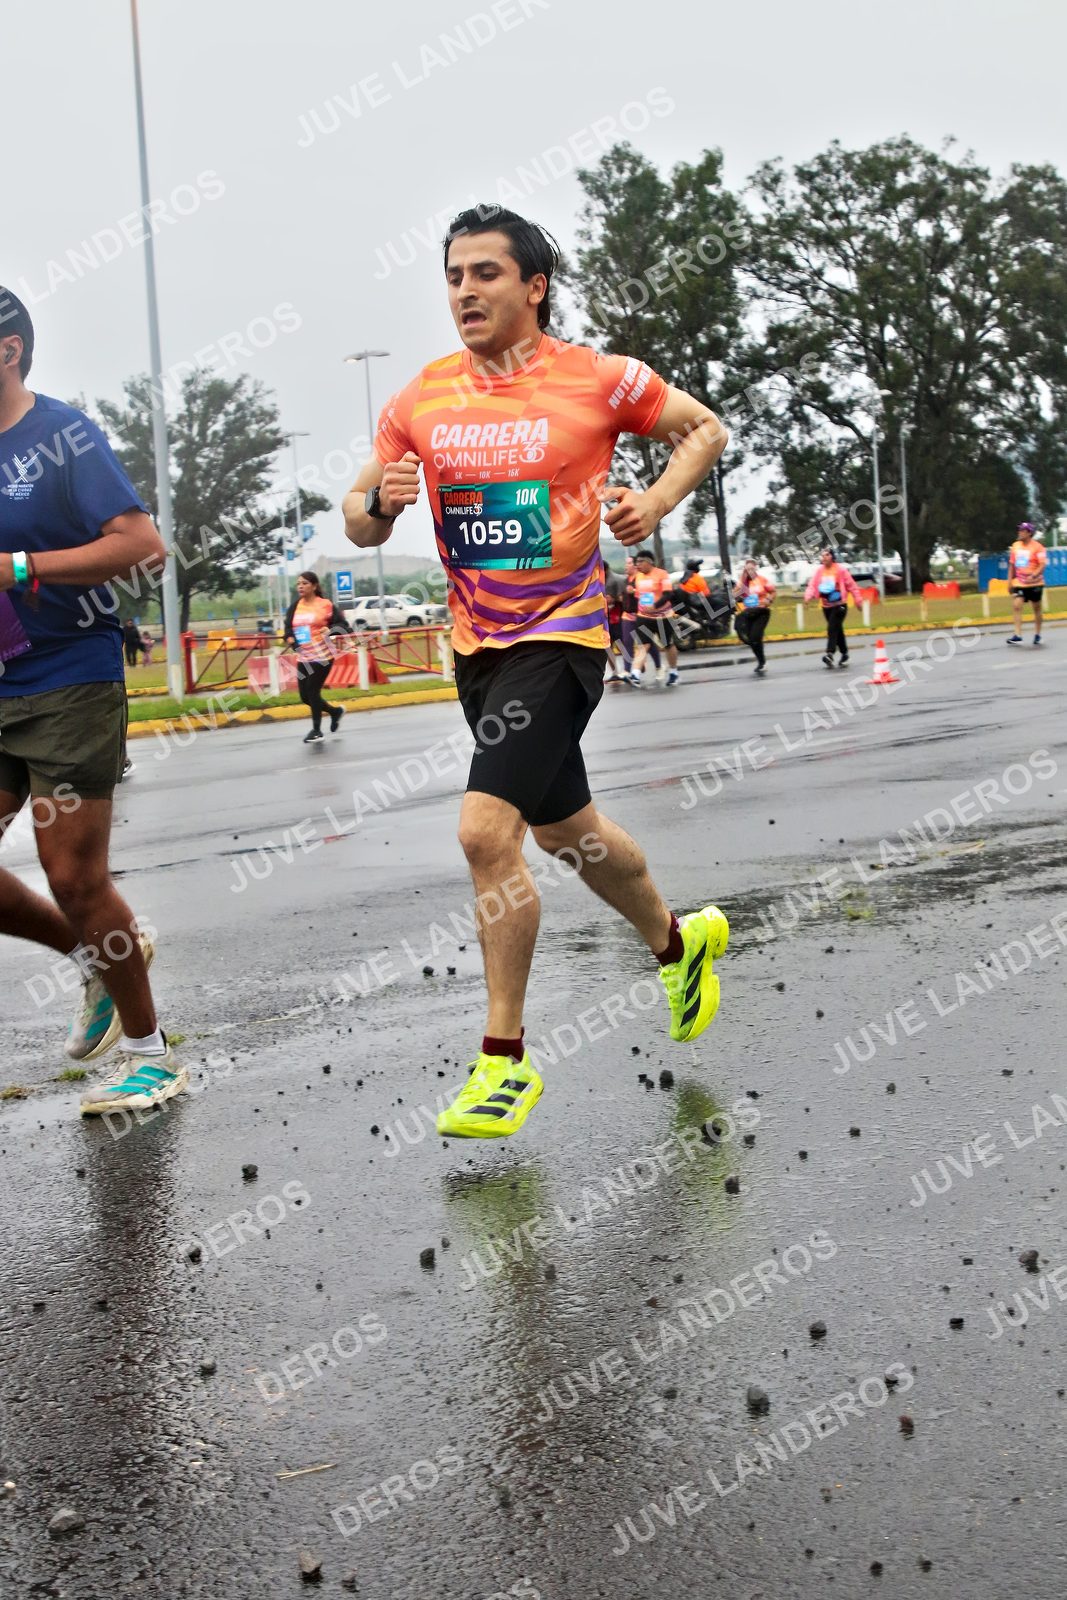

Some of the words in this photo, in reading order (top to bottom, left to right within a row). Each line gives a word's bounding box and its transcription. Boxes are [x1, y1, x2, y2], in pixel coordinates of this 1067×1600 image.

[431, 418, 549, 450] CARRERA
[433, 449, 518, 469] OMNILIFE
[479, 470, 491, 479] 10K
[444, 491, 483, 505] CARRERA
[515, 488, 539, 505] 10K
[445, 506, 474, 515] OMNILIFE
[459, 519, 522, 545] 1059
